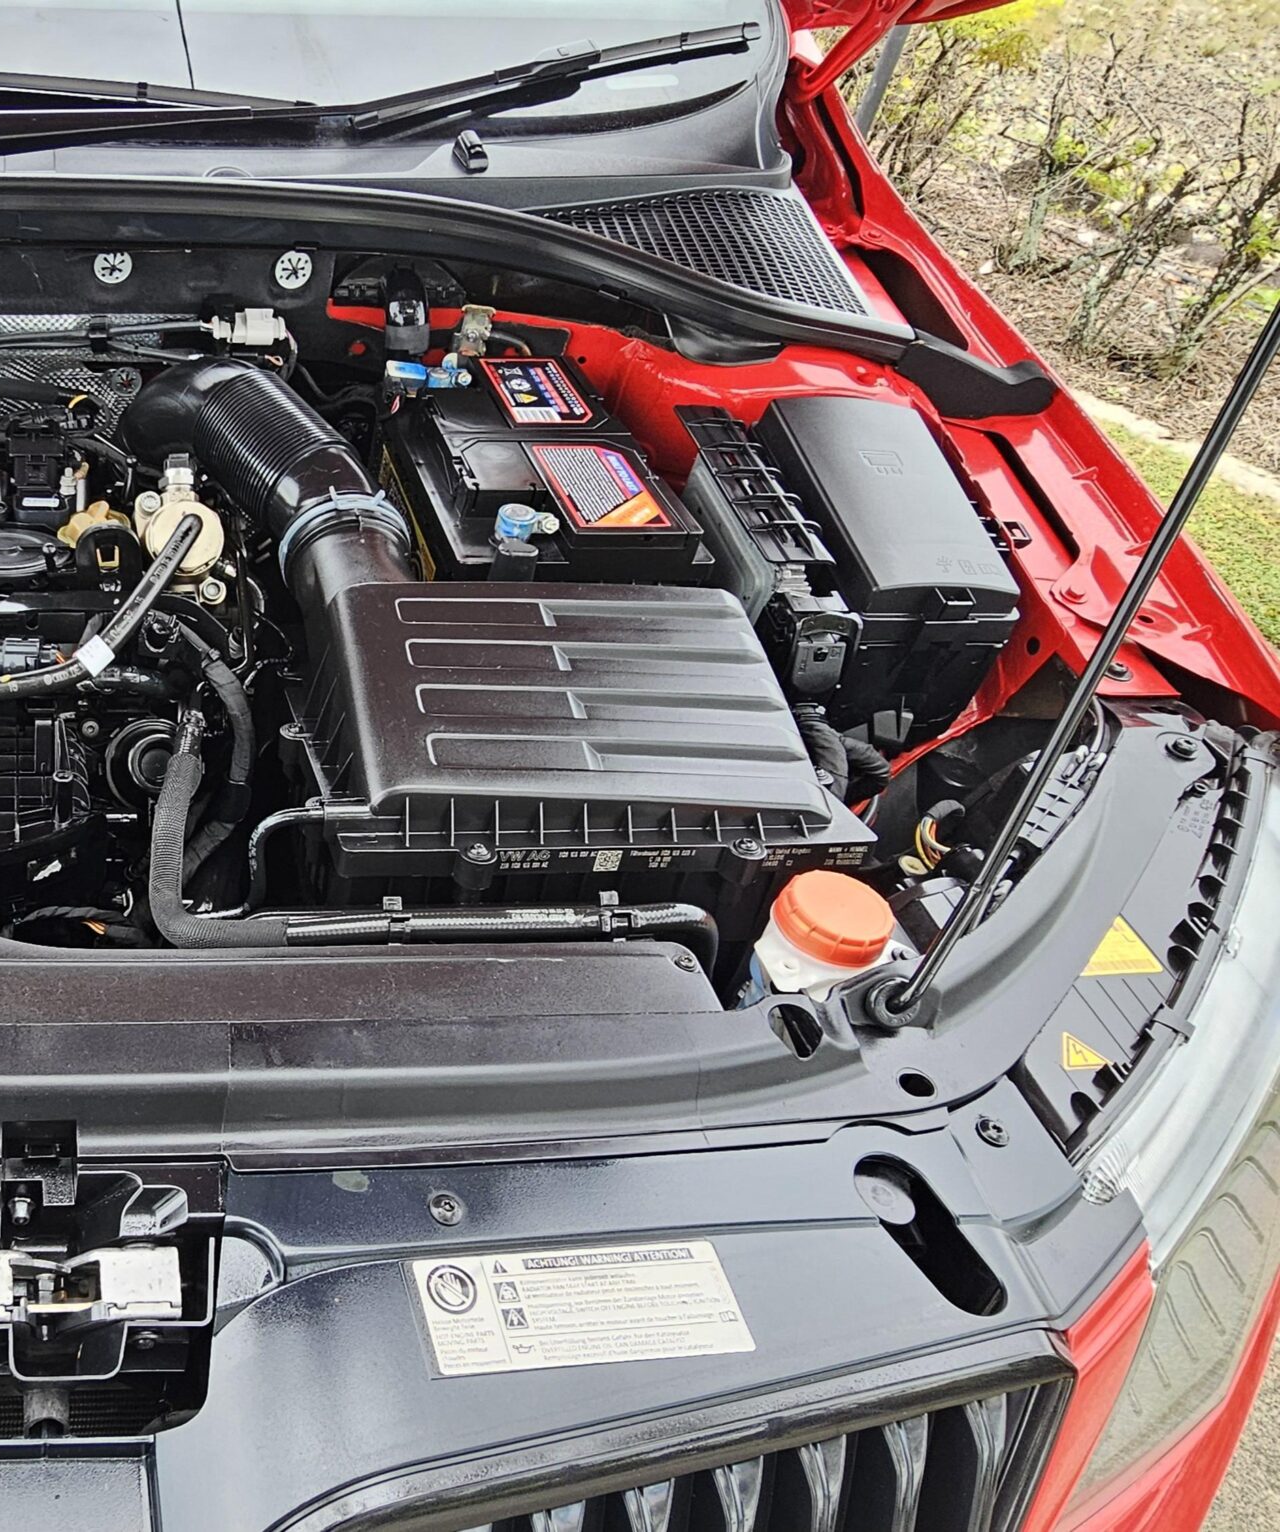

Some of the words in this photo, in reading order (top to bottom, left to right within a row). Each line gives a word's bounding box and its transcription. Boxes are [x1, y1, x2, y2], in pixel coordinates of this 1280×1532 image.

[500, 850, 526, 862] VW
[527, 850, 551, 861] AG
[526, 1256, 577, 1269] ACHTUNG!
[578, 1252, 632, 1266] WARNING!
[633, 1248, 690, 1262] ATTENTION!
